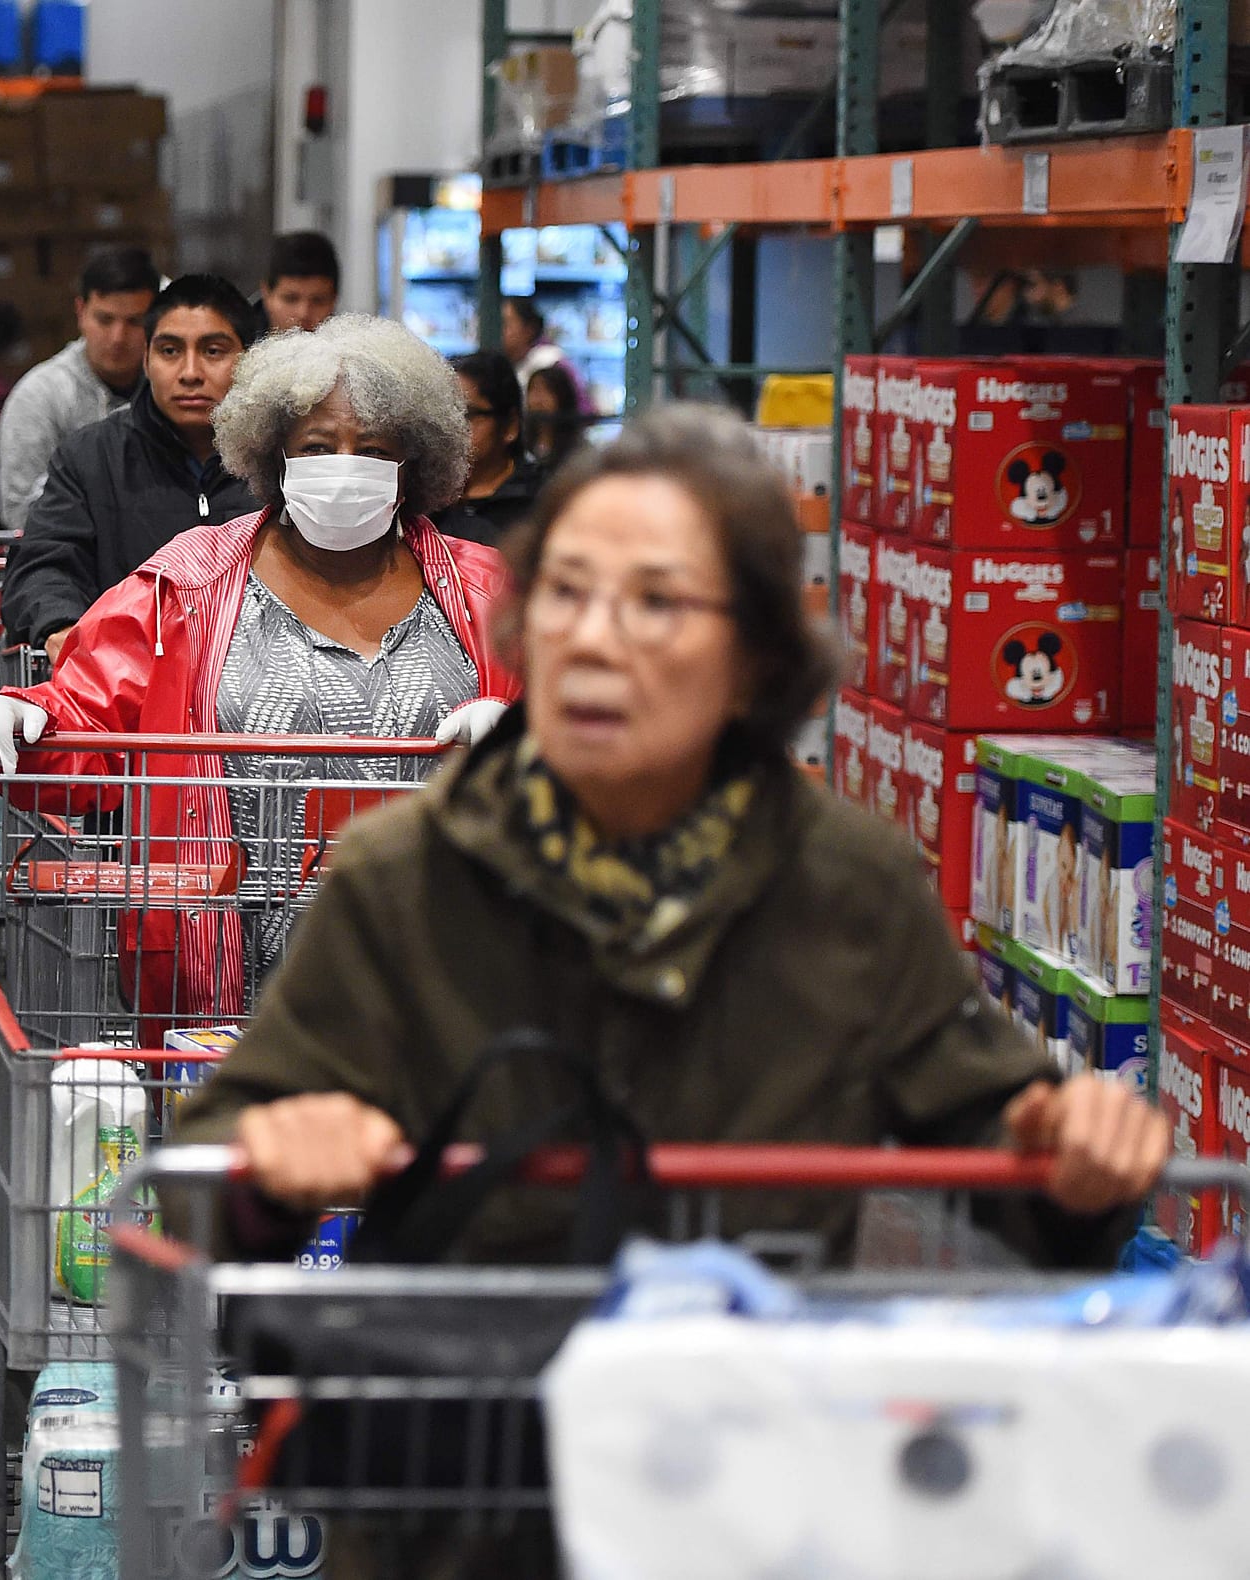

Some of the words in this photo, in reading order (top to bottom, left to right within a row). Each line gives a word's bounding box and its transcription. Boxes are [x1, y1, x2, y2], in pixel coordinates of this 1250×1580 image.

[977, 377, 1068, 403] HUGGIES
[1169, 419, 1230, 483] HUGGIES
[972, 558, 1064, 584] HUGGIES
[1173, 629, 1221, 699] HUGGIES
[1219, 1066, 1250, 1143] HUGG
[69, 1503, 94, 1513] Whole
